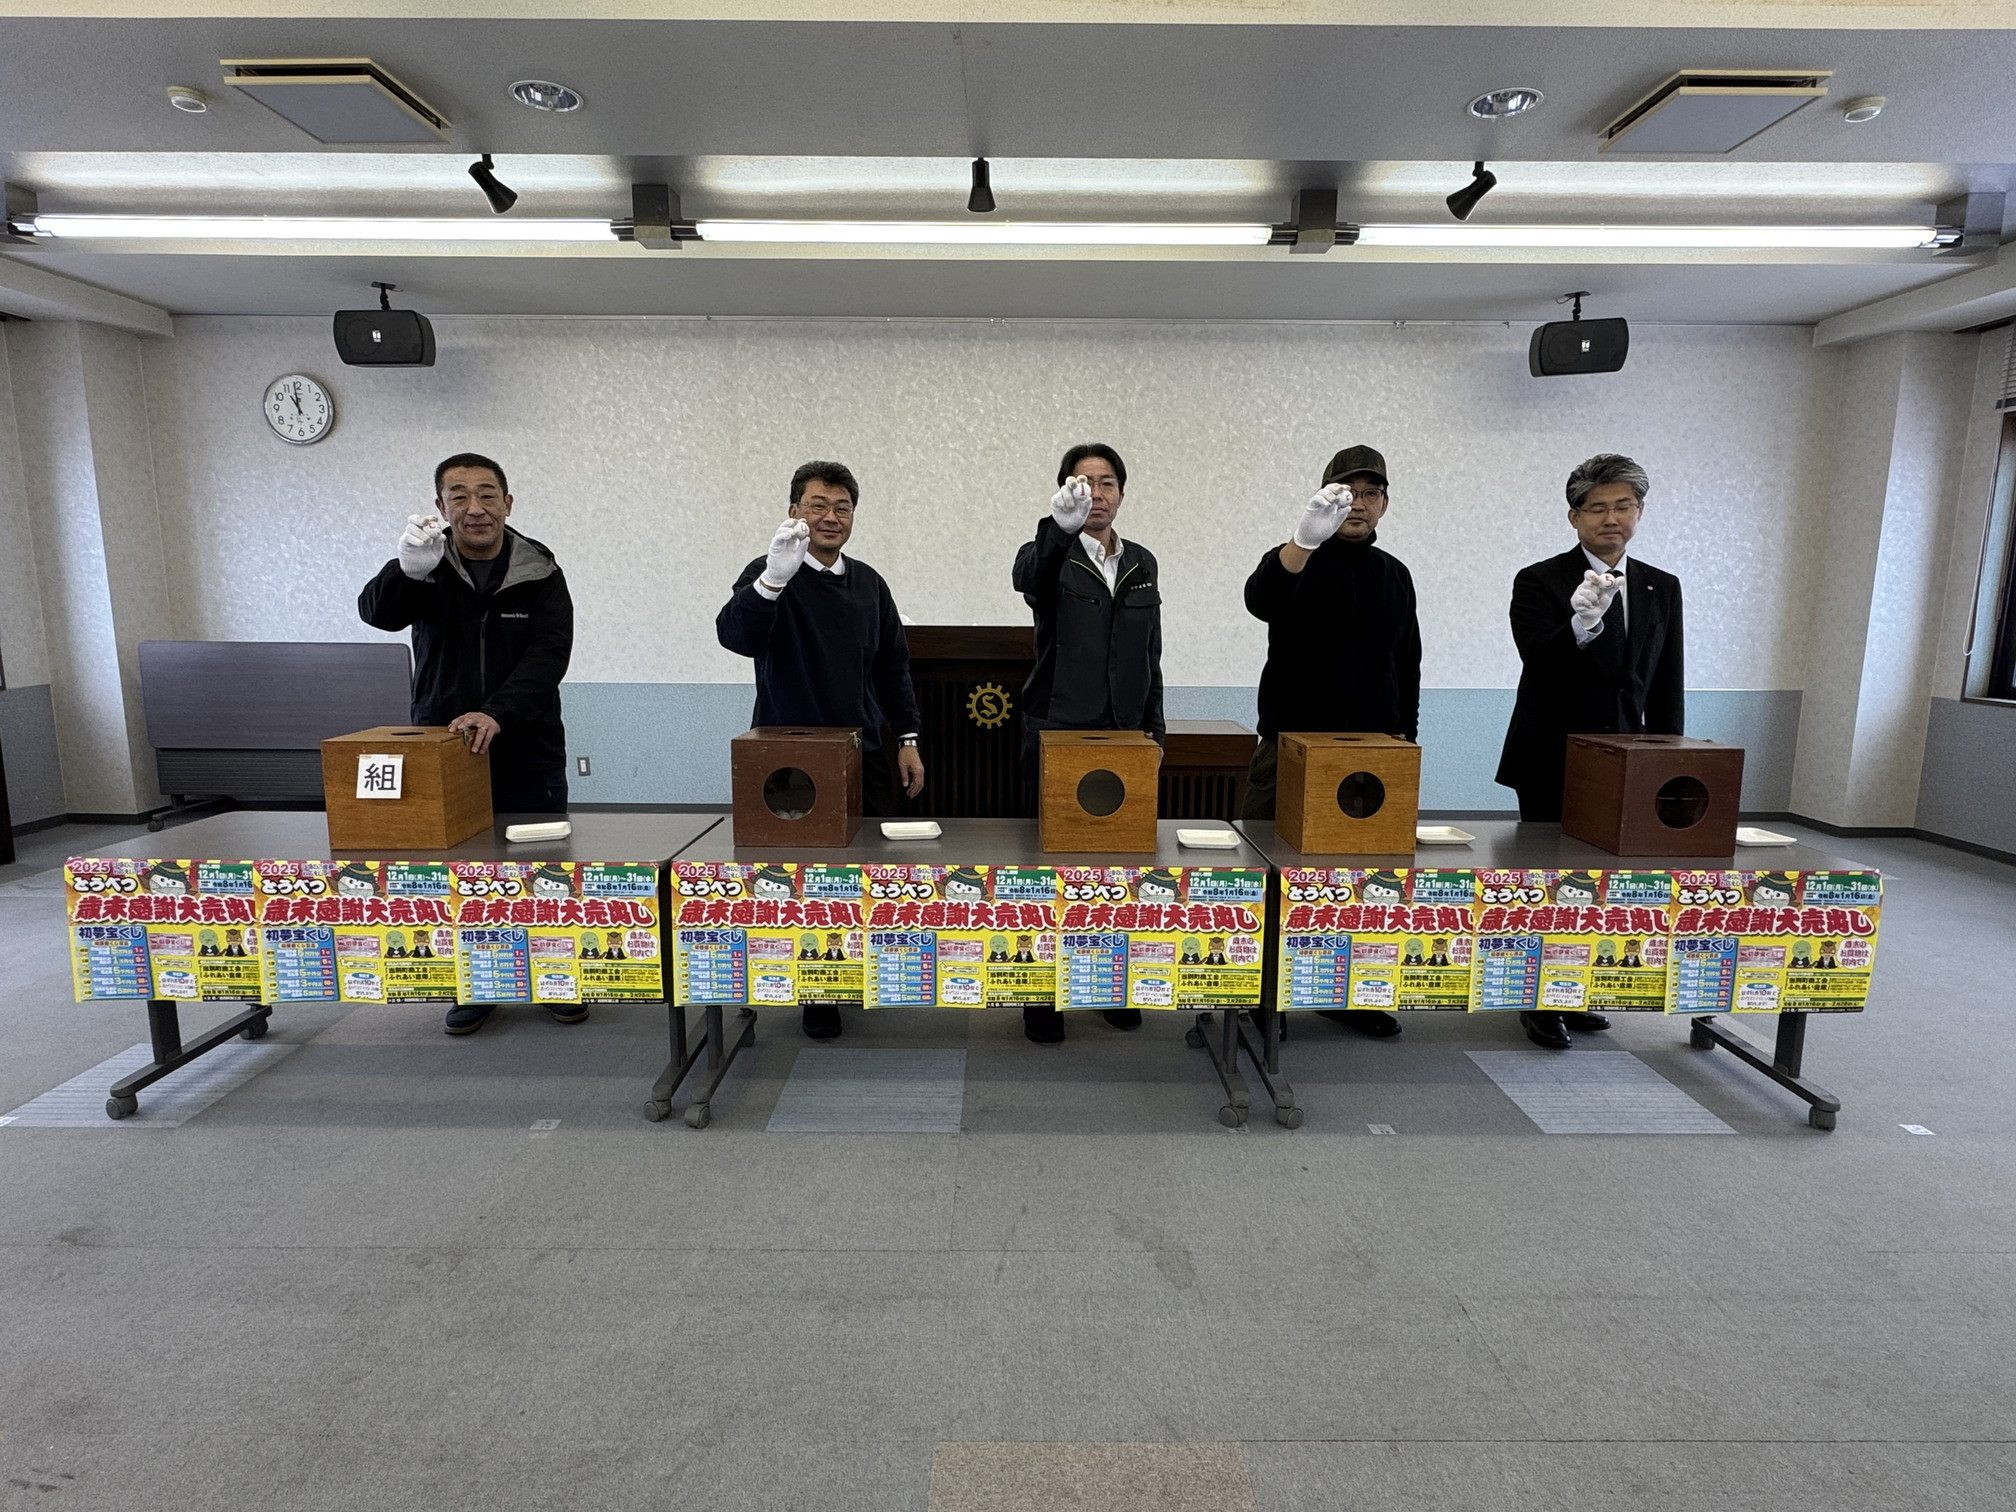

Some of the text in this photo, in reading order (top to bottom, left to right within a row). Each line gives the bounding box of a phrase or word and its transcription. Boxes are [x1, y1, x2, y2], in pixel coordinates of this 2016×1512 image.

[283, 384, 290, 393] 11
[307, 384, 311, 393] 1
[274, 392, 284, 401] 10
[315, 392, 321, 402] 2
[273, 404, 280, 413] 9
[319, 405, 325, 414] 3
[278, 416, 285, 425] 8
[317, 417, 323, 425] 4
[287, 424, 294, 433] 7
[298, 427, 305, 437] 6
[309, 425, 316, 433] 5
[1605, 575, 1614, 588] 5
[364, 763, 397, 792] 組
[70, 861, 110, 872] 2025
[259, 864, 298, 875] 2025
[456, 865, 494, 876] 2025
[677, 865, 716, 876] 2025
[869, 868, 907, 879] 2025
[1063, 870, 1101, 881] 2025
[1288, 871, 1326, 882] 2025
[1483, 873, 1519, 884] 2025
[1679, 874, 1716, 885] 2025
[72, 876, 138, 892] とうべつ
[261, 878, 326, 894] とうべつ
[457, 879, 522, 895] とうべつ
[678, 880, 743, 896] とうべつ
[869, 882, 933, 898] とうべつ
[1063, 884, 1127, 900] とうべつ
[1287, 885, 1351, 901] とうべつ
[1481, 888, 1544, 902] とうべつ
[1678, 889, 1740, 904] とうべつ
[460, 898, 653, 924] 歳末感謝大売出し
[1061, 902, 1258, 930] 歳末感謝大売出し
[1673, 907, 1871, 933] 歳末感謝大売出し
[77, 926, 142, 939] 初夢宝くじ
[265, 928, 329, 941] 初夢宝くじ
[461, 930, 524, 942] 初夢宝くじ
[679, 930, 743, 943] 初夢宝くじ
[869, 933, 932, 945] 初夢宝くじ
[1061, 934, 1124, 947] 初夢宝くじ
[1285, 935, 1347, 948] 初夢宝くじ
[1477, 937, 1539, 949] 初夢宝くじ
[1672, 939, 1734, 951] 初夢宝くじ
